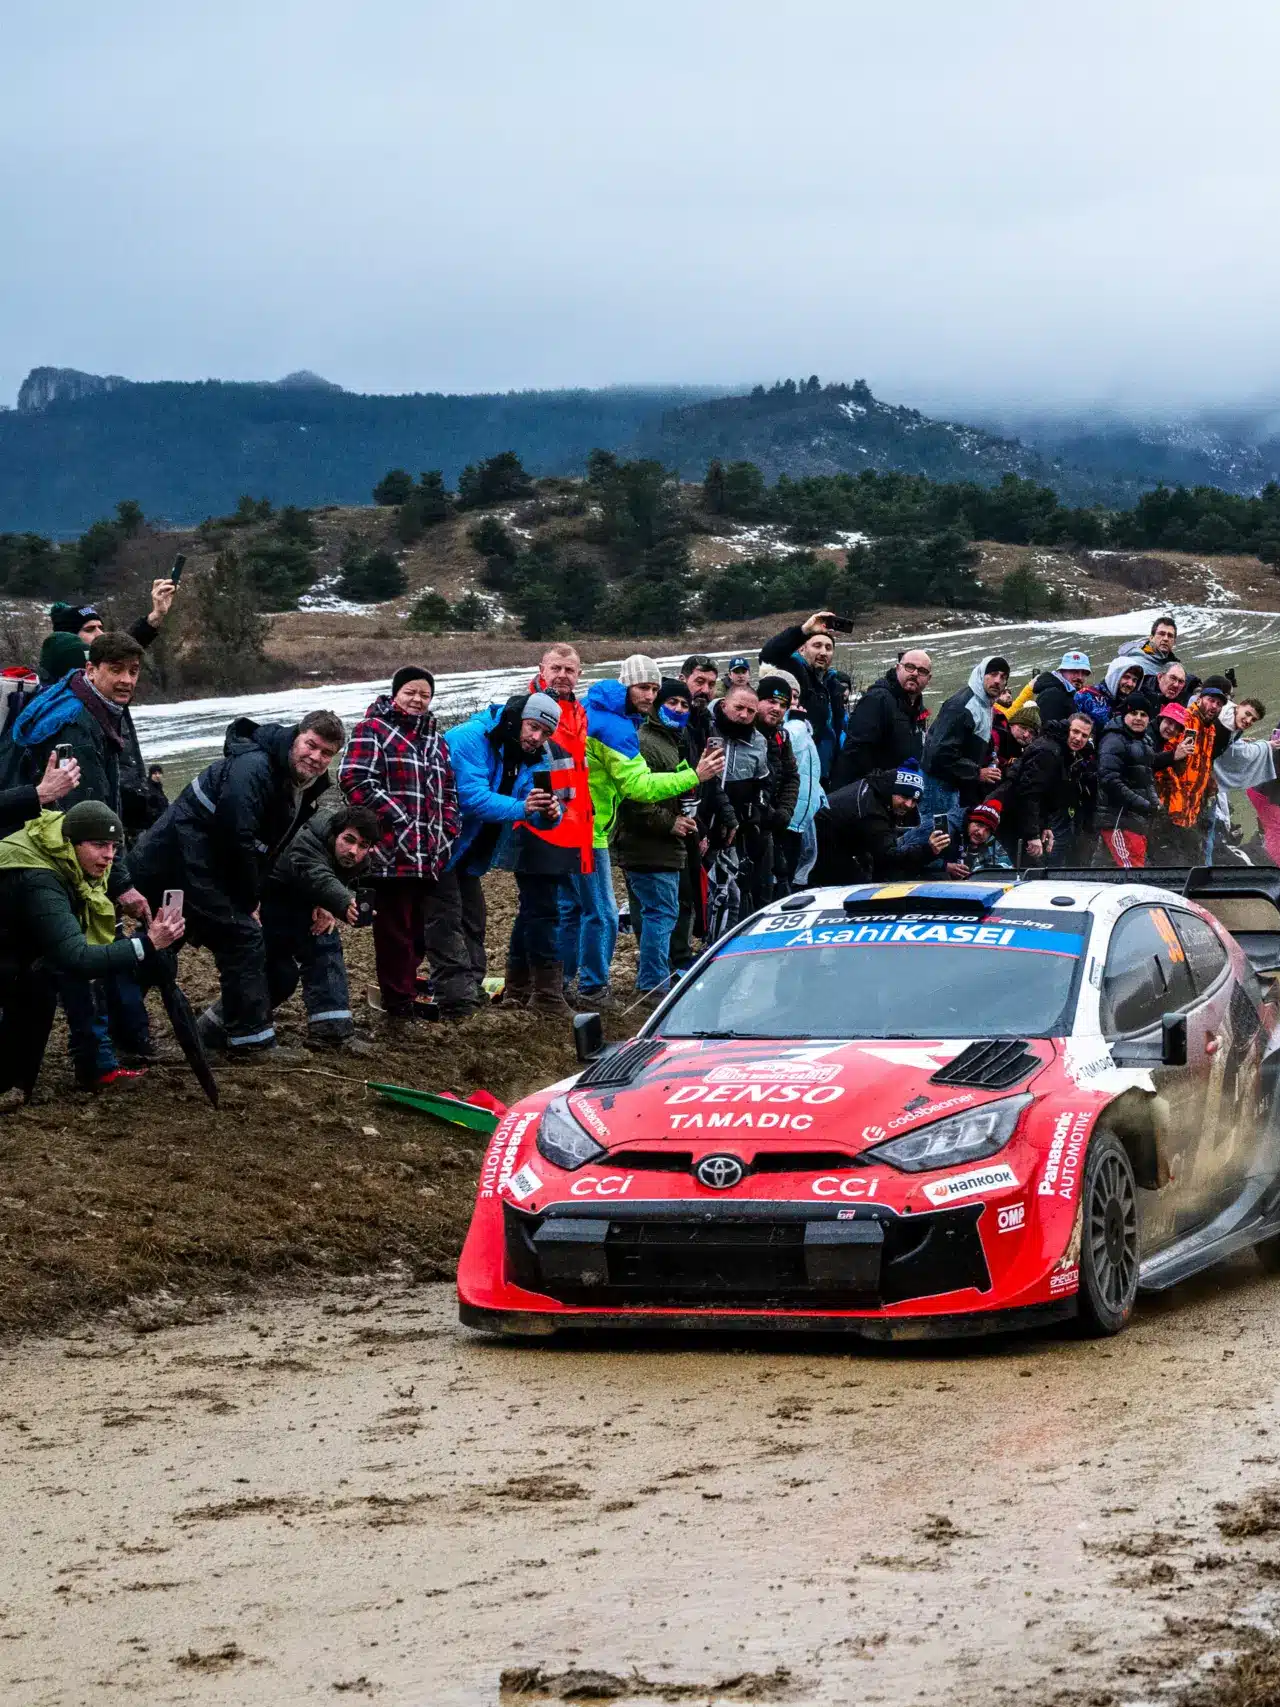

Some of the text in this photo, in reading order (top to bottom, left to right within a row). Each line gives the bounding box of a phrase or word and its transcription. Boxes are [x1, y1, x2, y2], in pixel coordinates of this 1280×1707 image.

[765, 913, 807, 931] 99
[816, 912, 1054, 929] TOYOTA GAZOO Racing
[664, 1084, 846, 1105] DENSO
[669, 1112, 813, 1130] TAMADIC
[481, 1111, 520, 1198] AUTOMOTIVE
[497, 1111, 540, 1195] Panasonic
[1038, 1111, 1074, 1197] Panasonic
[1059, 1111, 1093, 1200] AUTOMOTIVE
[998, 1206, 1025, 1229] OMP
